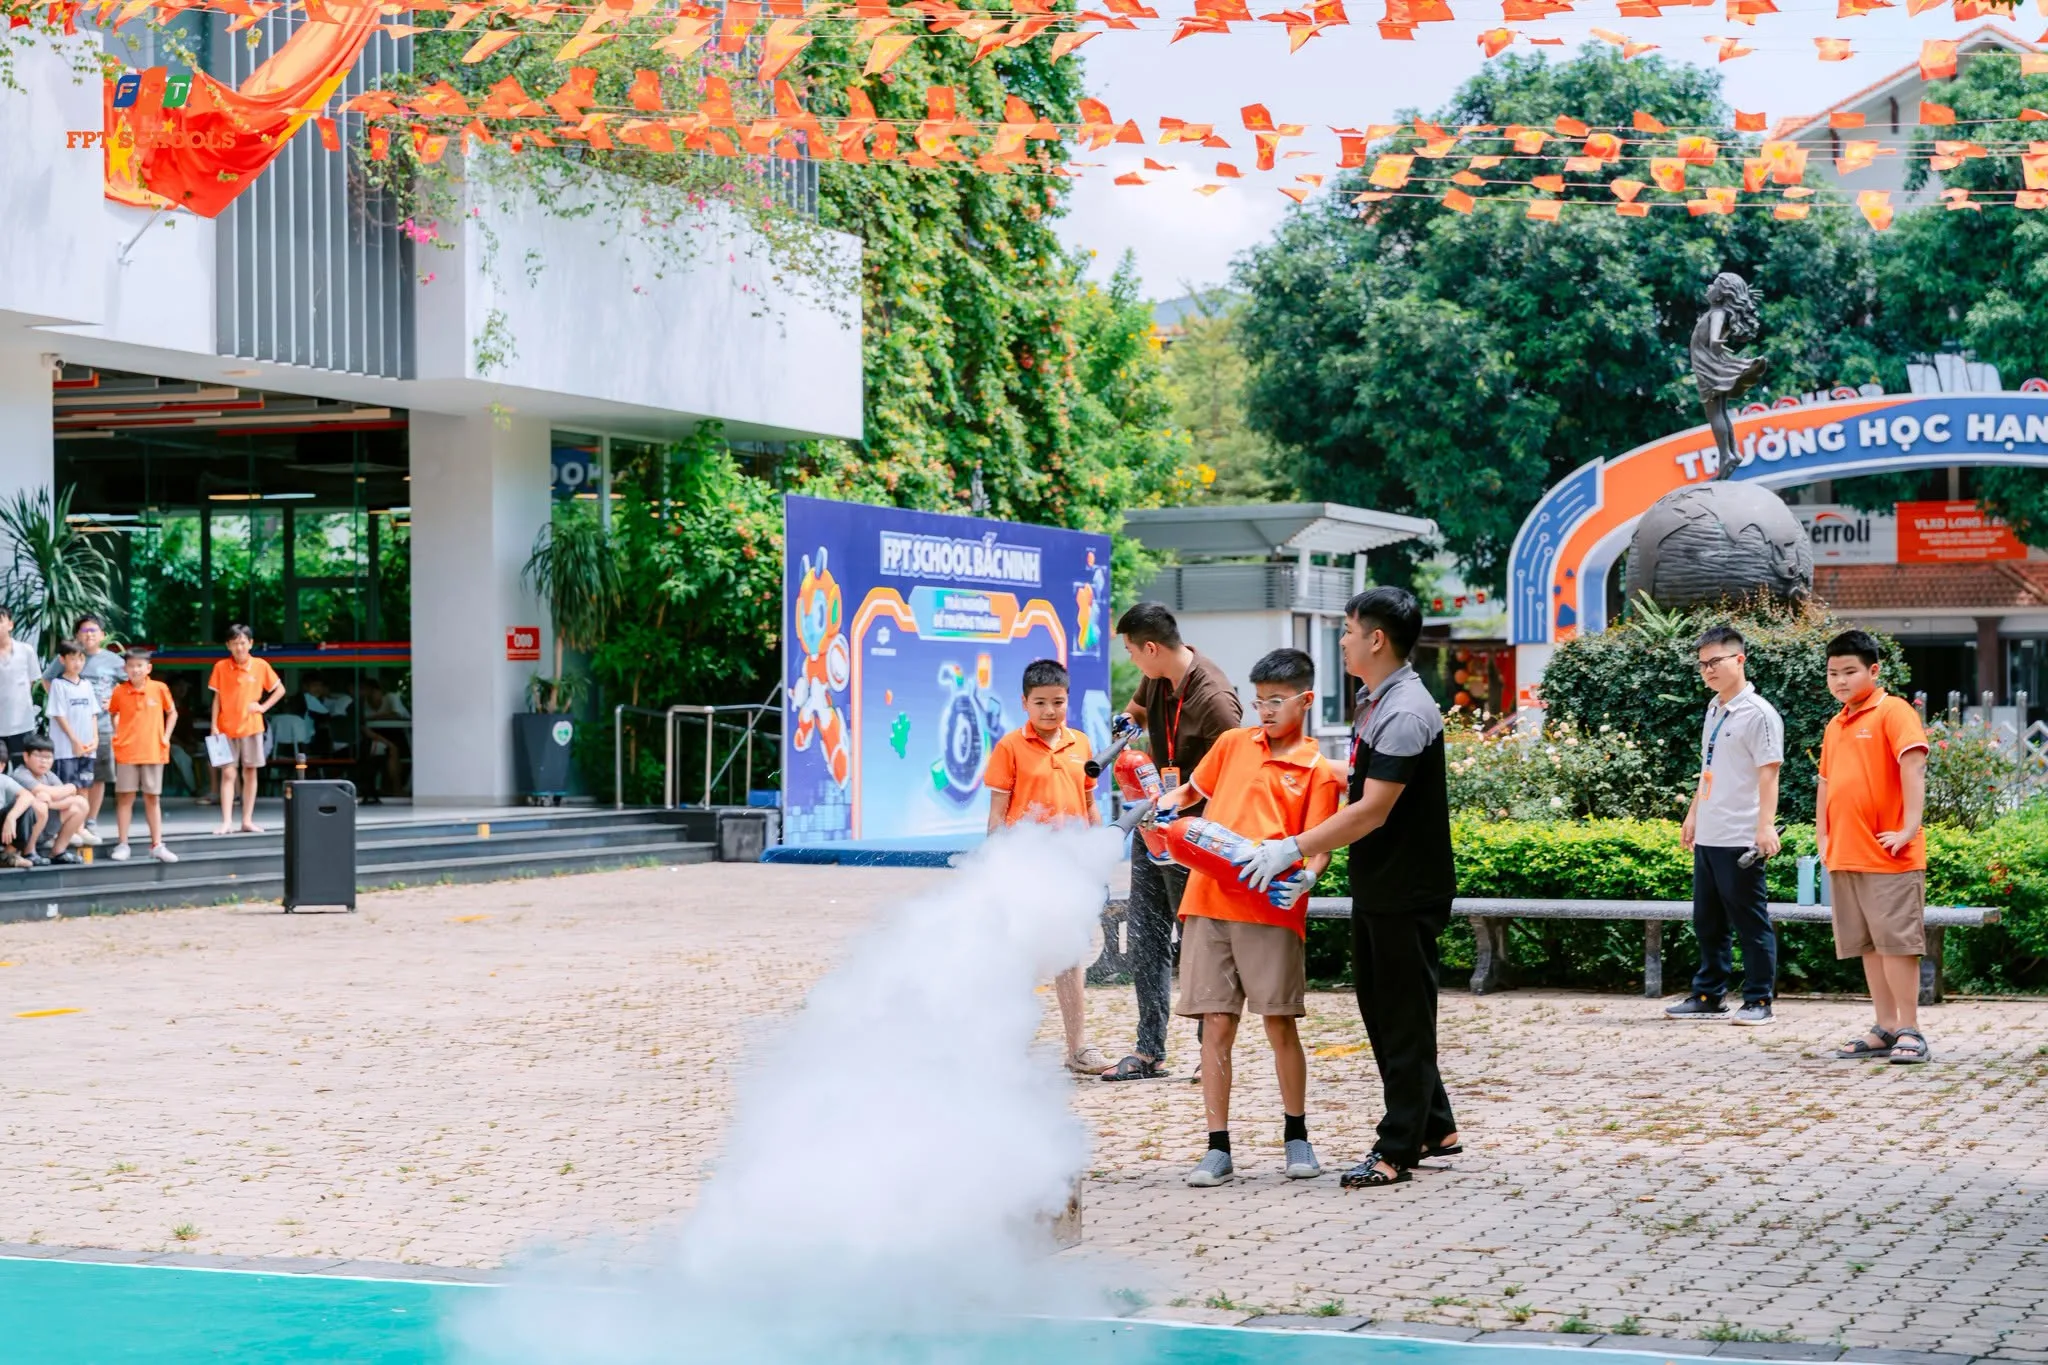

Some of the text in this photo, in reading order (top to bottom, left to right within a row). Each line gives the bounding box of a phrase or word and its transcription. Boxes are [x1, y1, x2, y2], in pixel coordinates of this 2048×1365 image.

[1675, 422, 1847, 481] TRƯỜNG
[1859, 413, 1951, 452] HỌC
[883, 537, 1040, 582] FPT SCHOOL BẮC NINH
